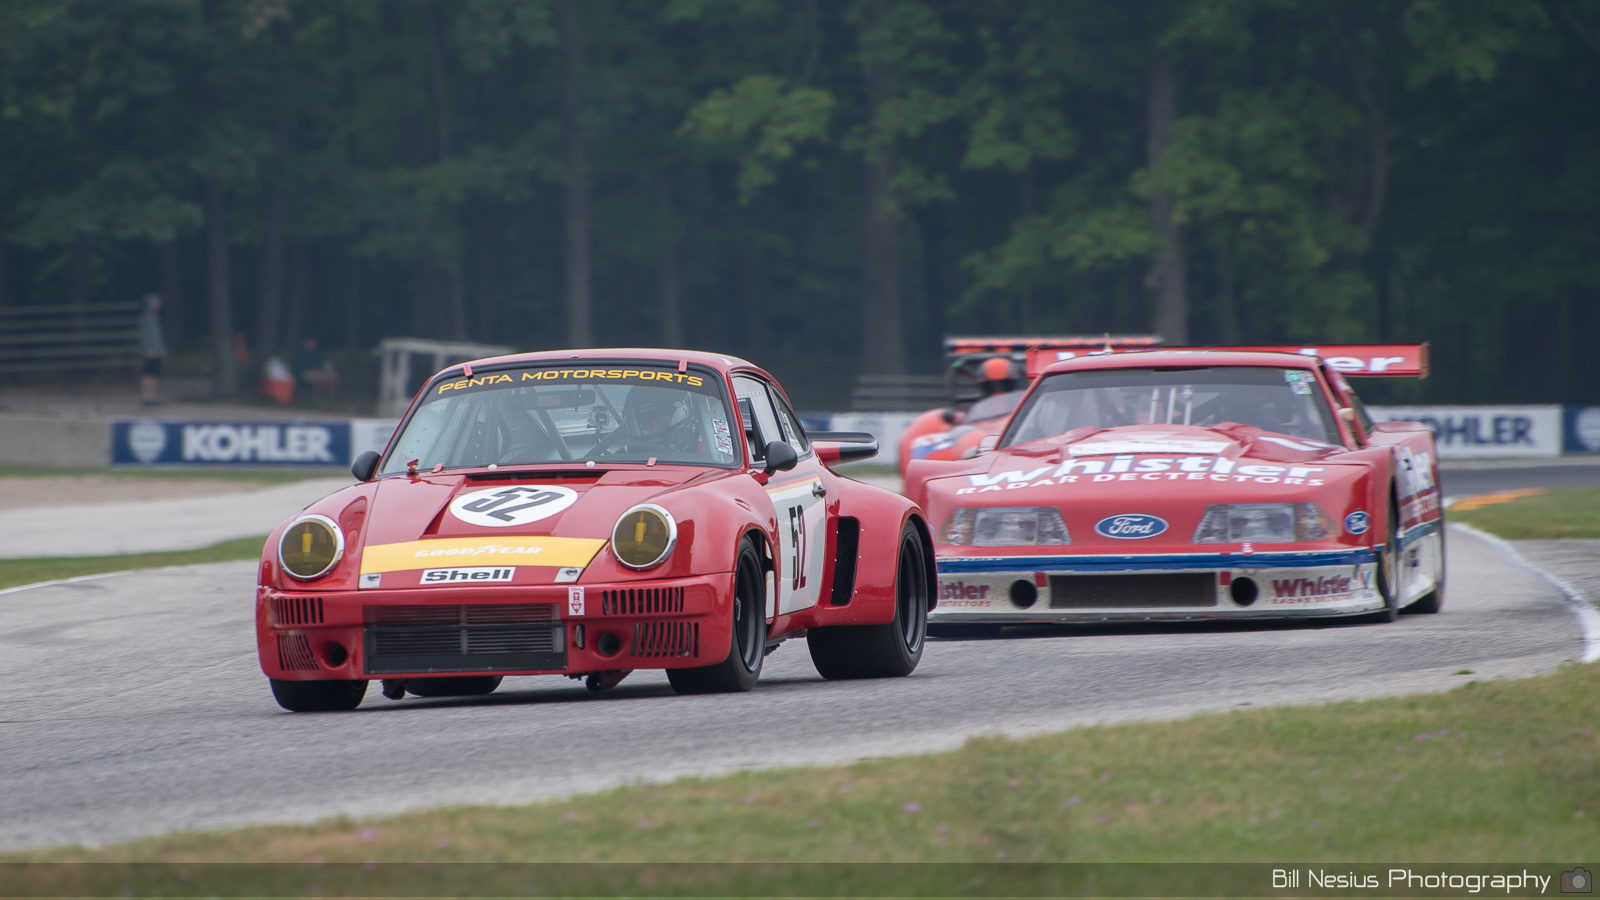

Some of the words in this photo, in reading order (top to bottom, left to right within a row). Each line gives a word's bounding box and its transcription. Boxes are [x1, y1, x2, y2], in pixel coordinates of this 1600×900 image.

[438, 374, 513, 394] PENTA
[521, 369, 703, 387] MOTORSPORTS
[182, 425, 335, 461] KOHLER
[1390, 415, 1535, 446] OHLER
[955, 475, 1079, 495] RADAR
[1092, 472, 1325, 486] DECTECTORS
[967, 455, 1326, 486] Whistler
[462, 486, 565, 522] 52
[1108, 516, 1155, 534] Ford
[414, 545, 543, 557] GOODYEAR
[788, 504, 806, 591] 52
[425, 569, 511, 581] Shell
